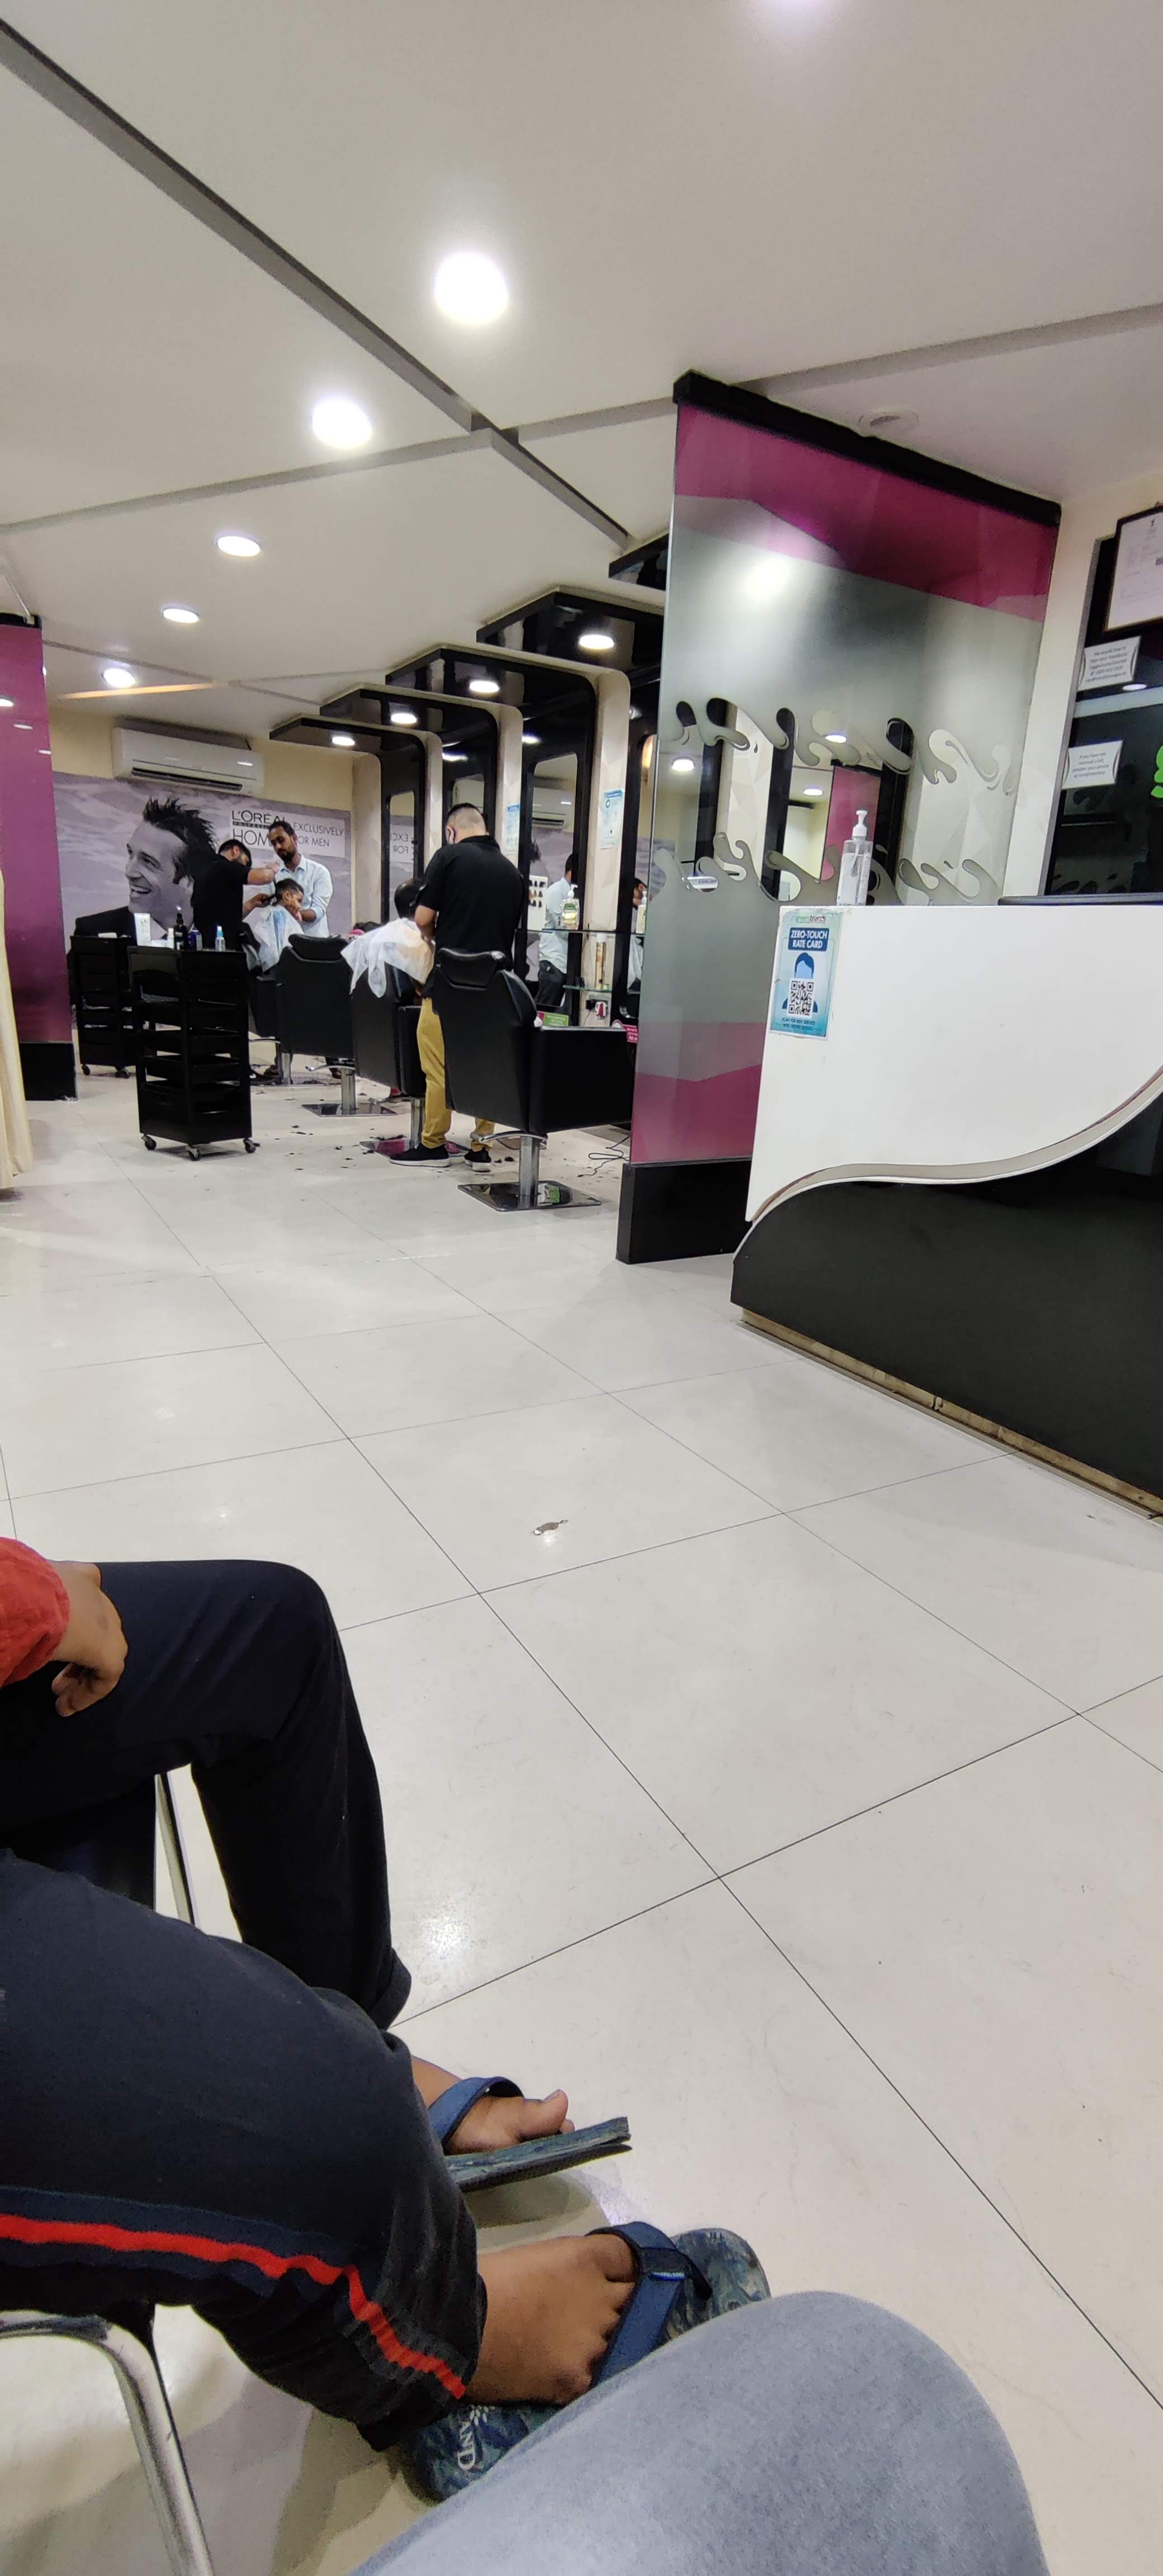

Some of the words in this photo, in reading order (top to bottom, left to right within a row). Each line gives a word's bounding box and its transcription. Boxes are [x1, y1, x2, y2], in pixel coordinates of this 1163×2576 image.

[293, 822, 344, 836] EXCLUSIVELY
[233, 828, 272, 846] HOM
[297, 836, 309, 845] OR
[311, 837, 330, 847] MEN
[791, 930, 828, 939] ZERO-TOUCH
[792, 939, 806, 948] RATE
[806, 940, 823, 949] CARD
[457, 2420, 476, 2471] AND
